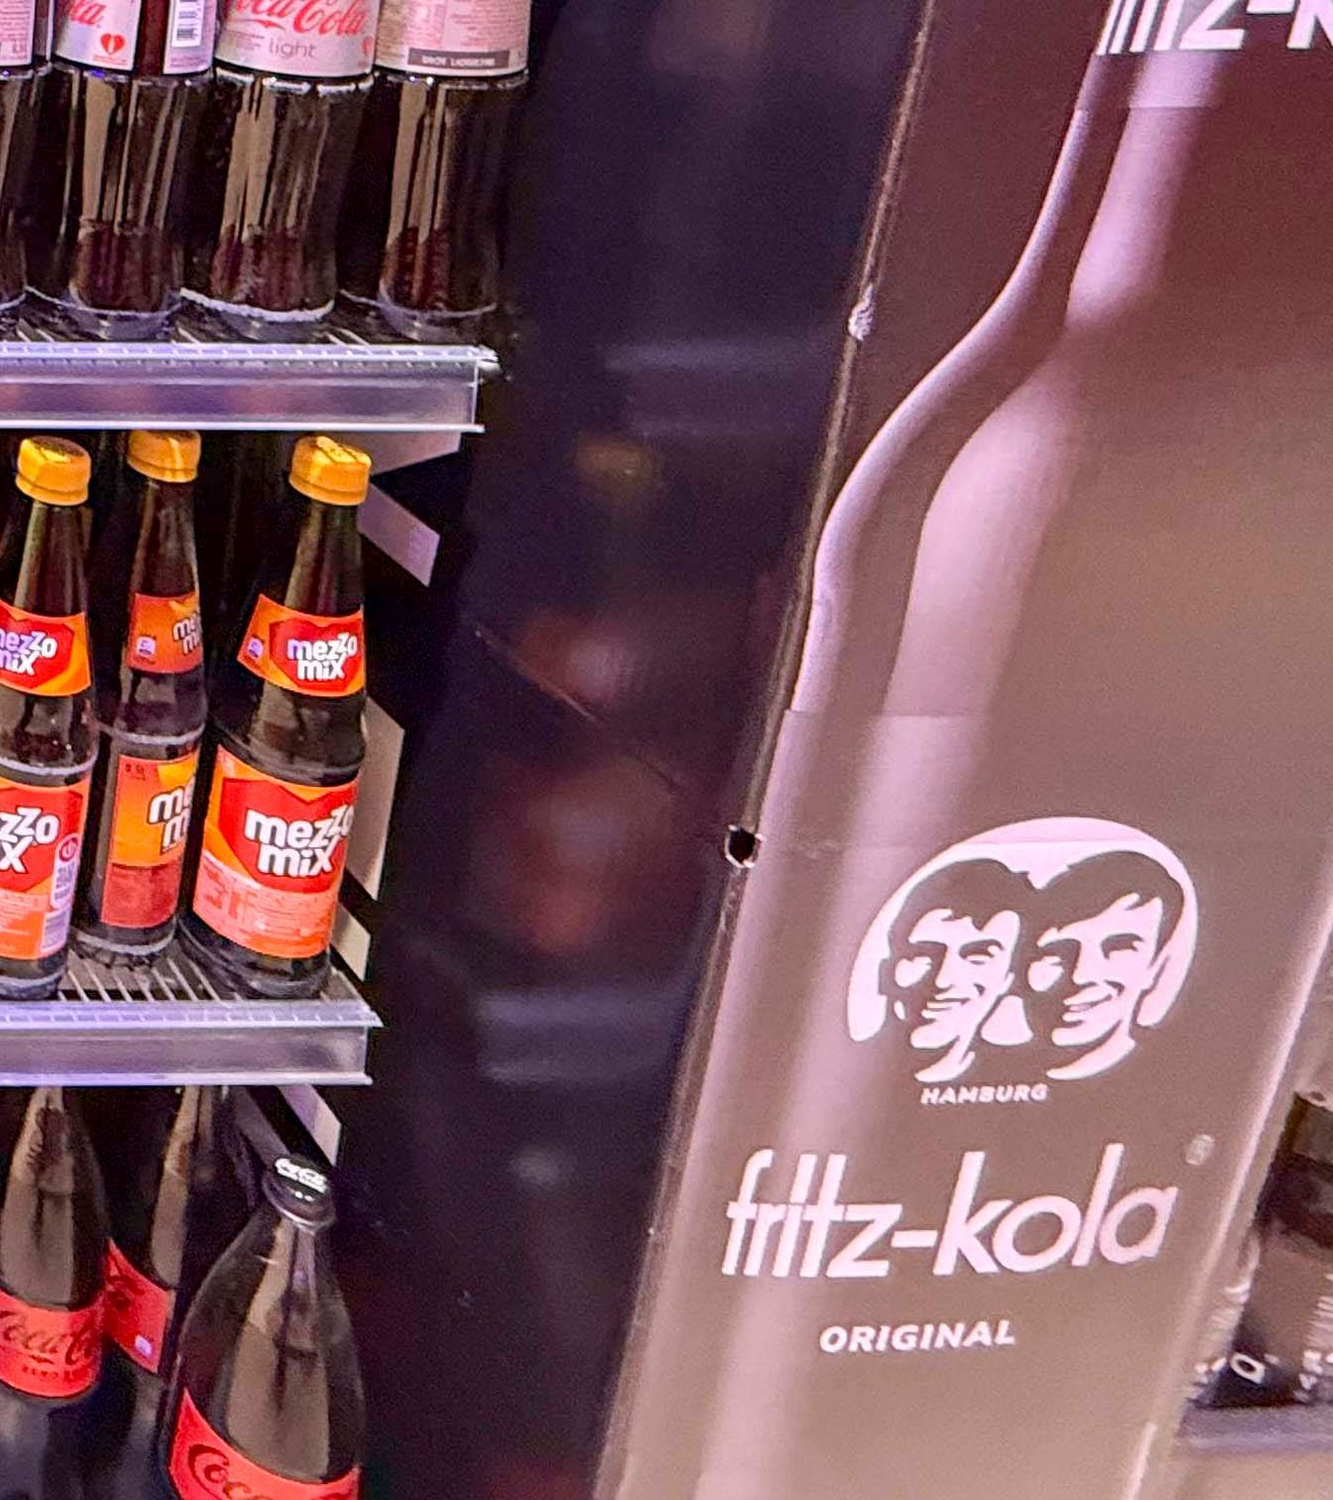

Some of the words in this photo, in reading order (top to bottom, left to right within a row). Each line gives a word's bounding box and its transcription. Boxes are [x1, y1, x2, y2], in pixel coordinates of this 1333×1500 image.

[268, 36, 317, 60] light
[287, 631, 358, 662] mezzo
[297, 653, 347, 681] mix
[244, 804, 354, 851] mezzo
[256, 833, 337, 879] mix
[920, 1082, 1049, 1105] HAMBURG
[721, 1142, 1179, 1279] fritz-kola
[819, 1319, 1016, 1354] ORIGINAL
